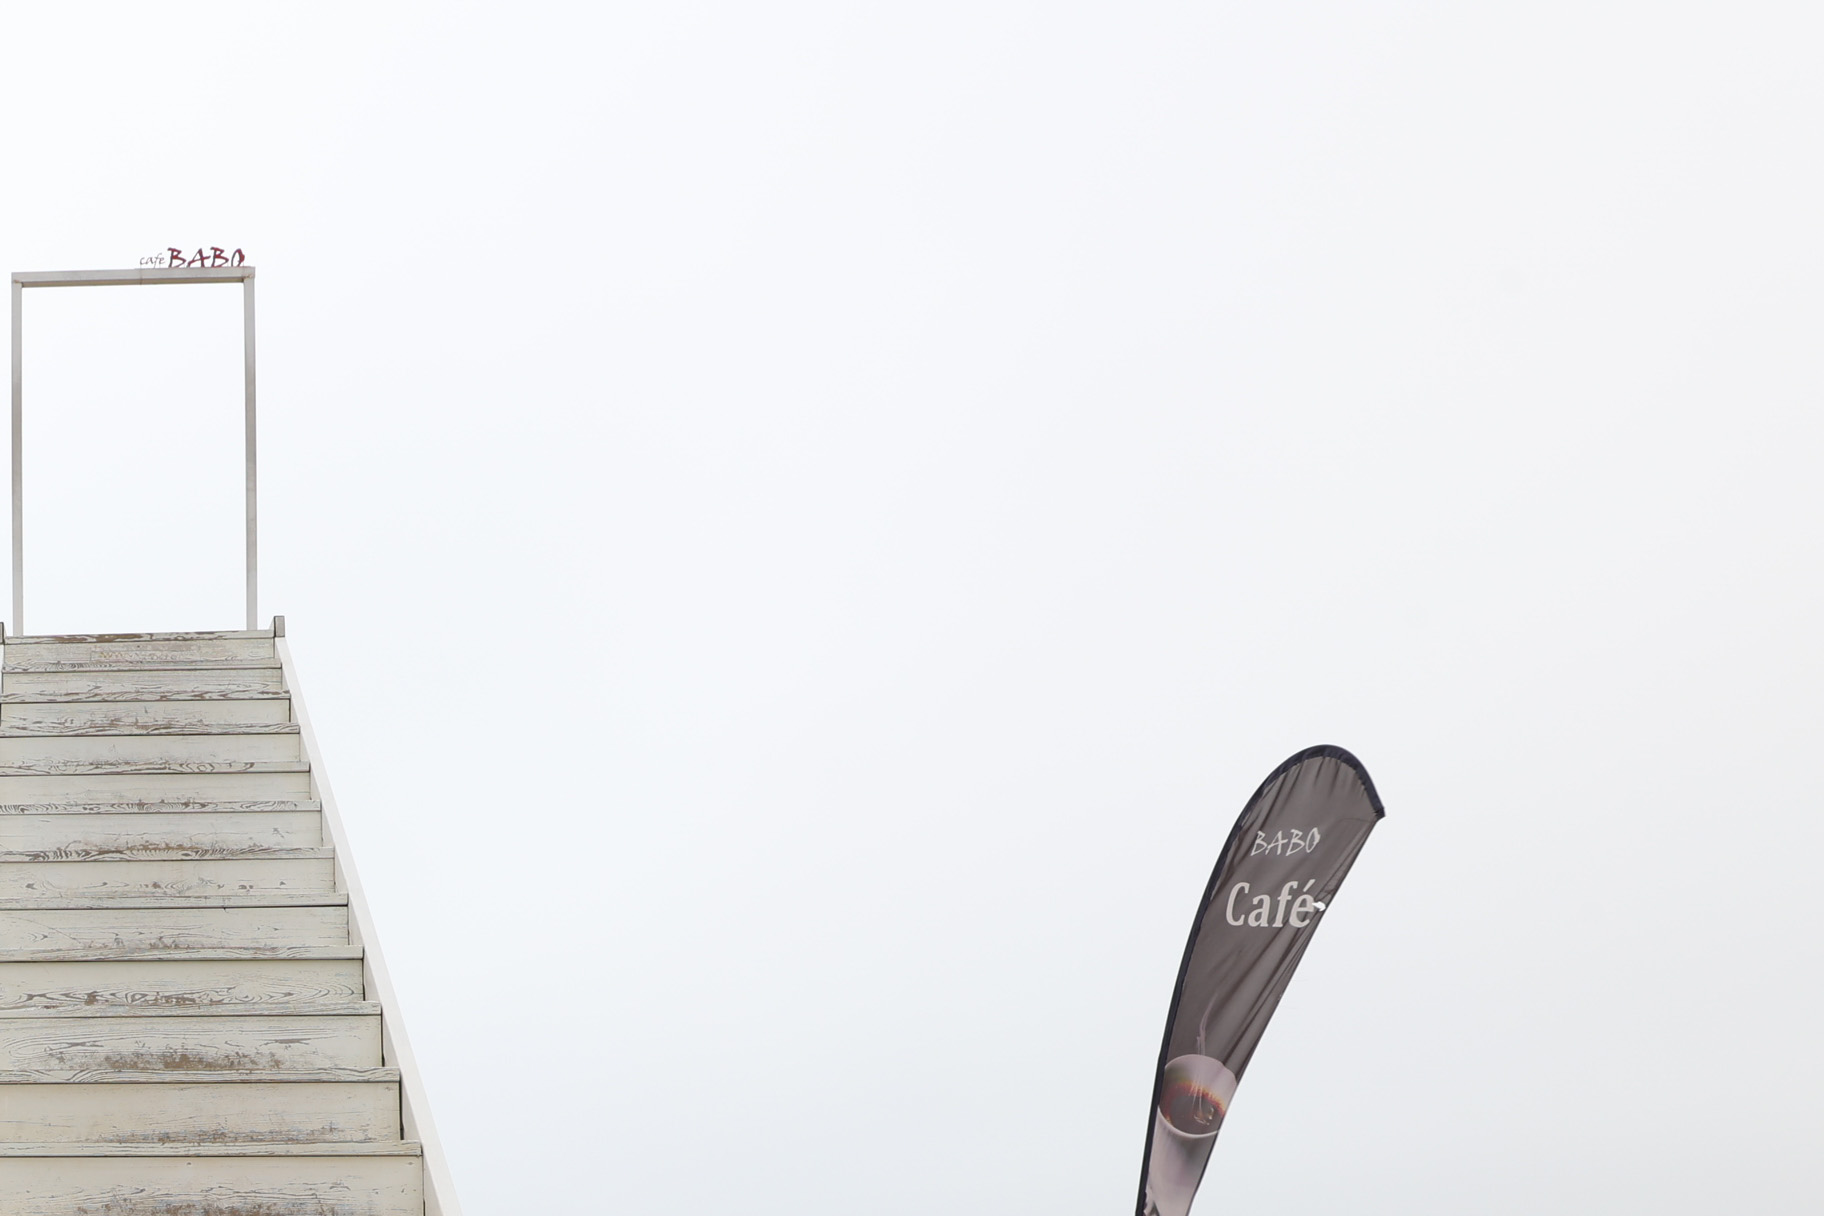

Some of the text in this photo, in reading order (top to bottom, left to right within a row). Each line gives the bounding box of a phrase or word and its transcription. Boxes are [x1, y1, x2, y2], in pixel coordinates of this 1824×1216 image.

[139, 246, 246, 269] cafe BABO
[1250, 827, 1321, 856] BABO
[1226, 879, 1316, 927] Café
